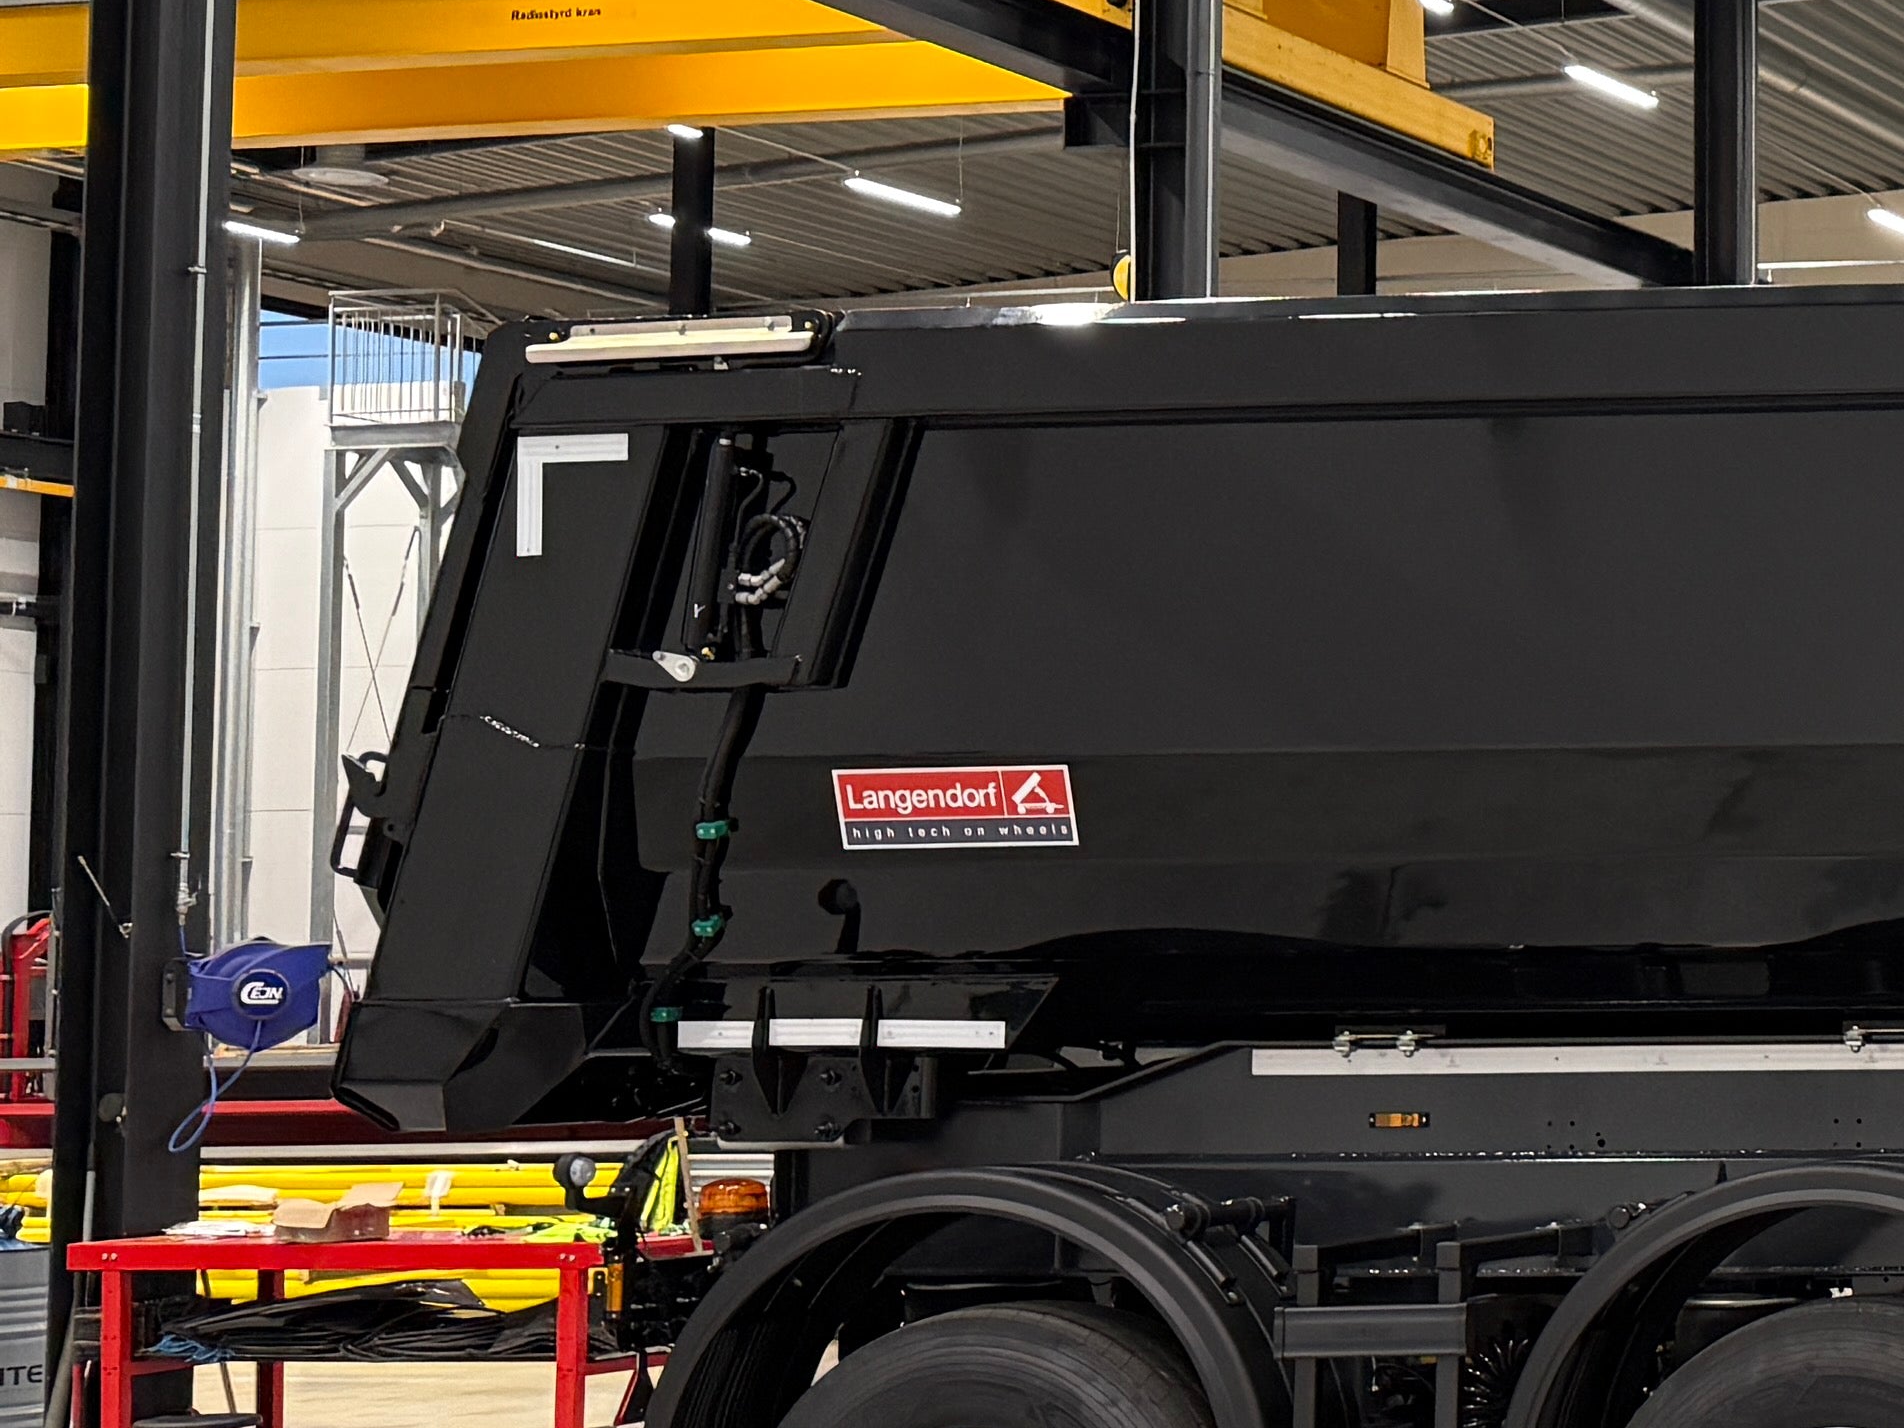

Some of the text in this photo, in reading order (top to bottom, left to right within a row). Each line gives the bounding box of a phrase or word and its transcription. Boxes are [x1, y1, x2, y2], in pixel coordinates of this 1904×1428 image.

[846, 782, 997, 814] Langendorf
[852, 827, 895, 840] high
[964, 827, 985, 837] on
